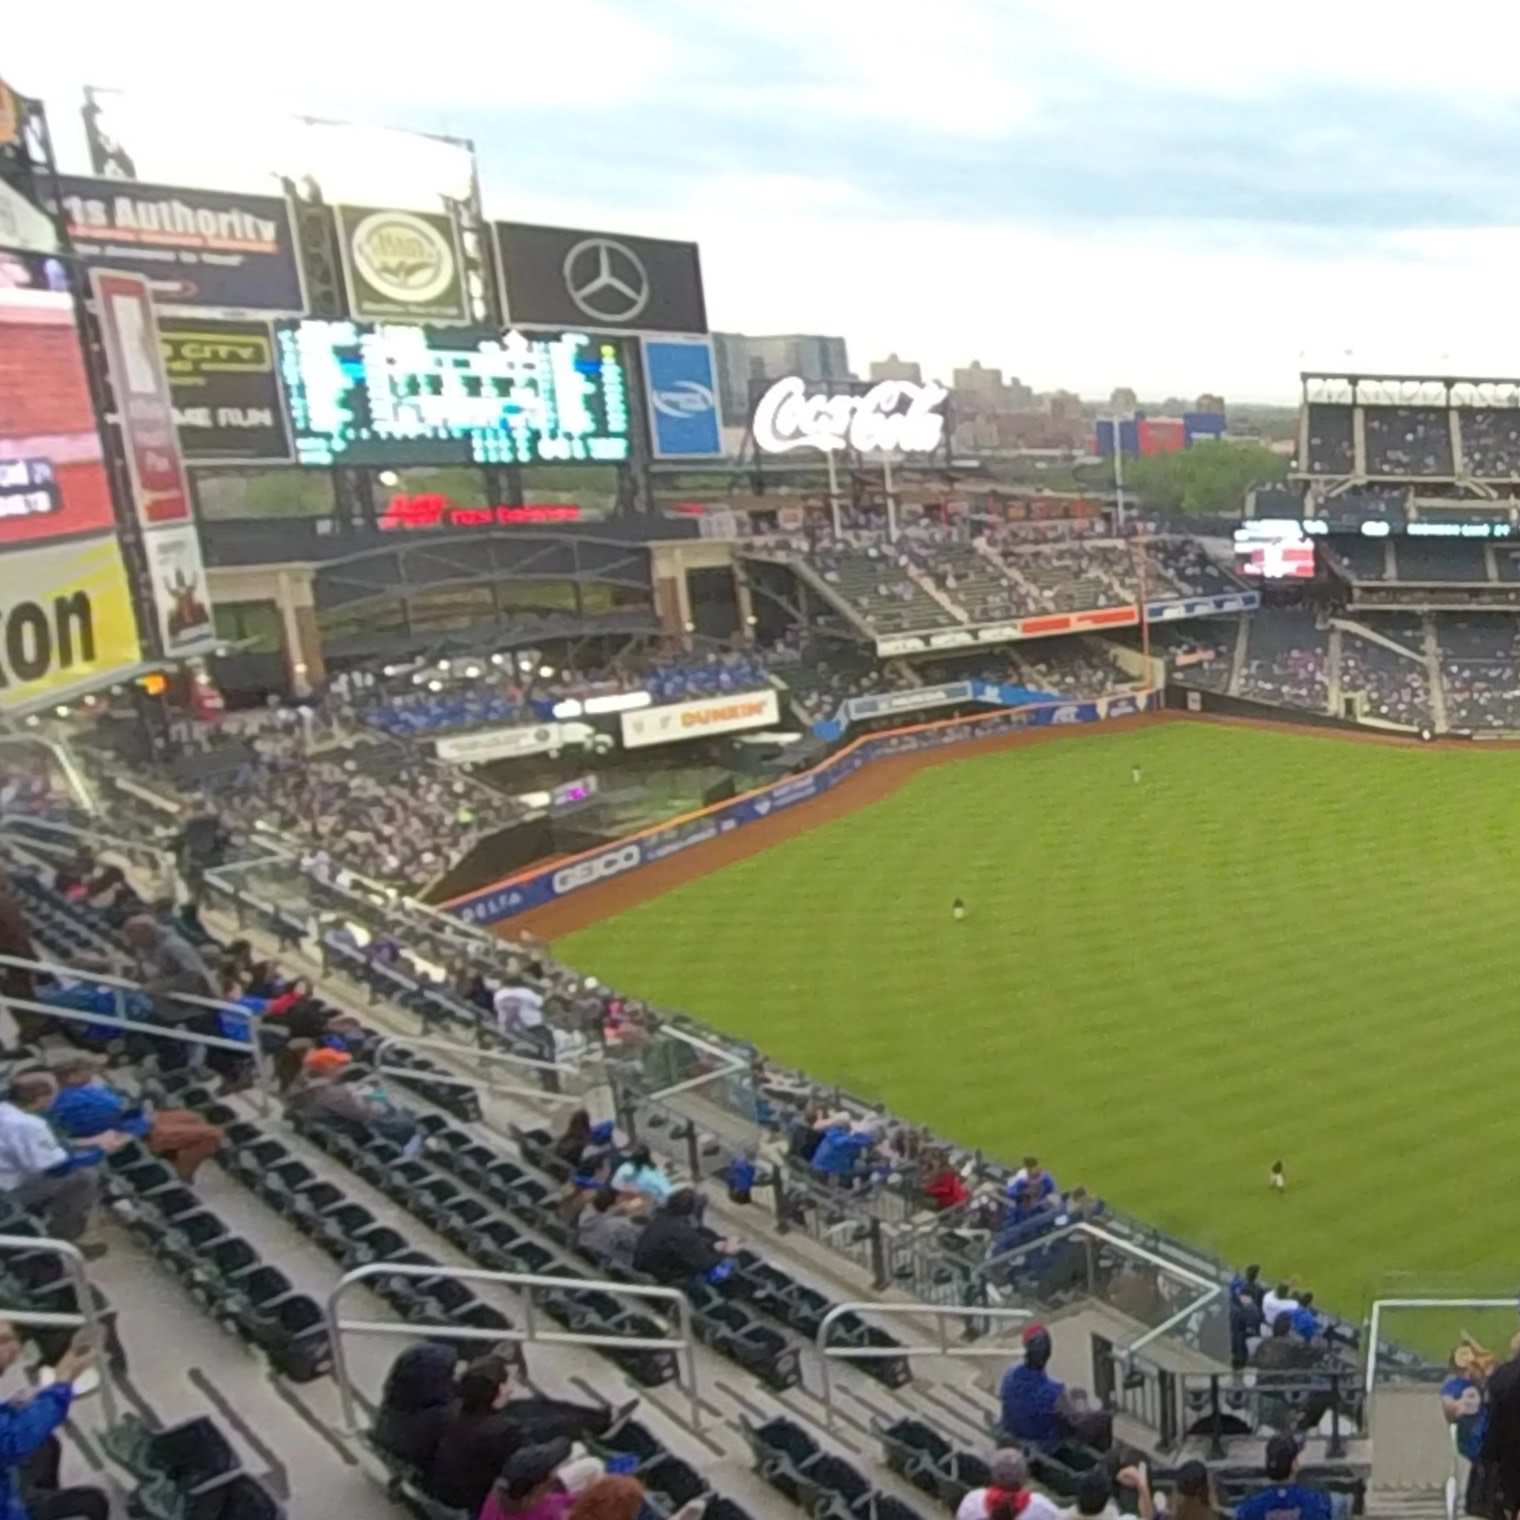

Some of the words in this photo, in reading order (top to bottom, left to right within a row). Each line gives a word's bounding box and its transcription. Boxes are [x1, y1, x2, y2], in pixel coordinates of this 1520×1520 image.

[113, 197, 276, 241] Authority
[180, 343, 255, 359] CITY
[171, 407, 213, 428] ME
[216, 408, 273, 428] RUN
[1, 590, 96, 688] on
[553, 844, 641, 894] GEICO
[462, 892, 523, 924] DELTA
